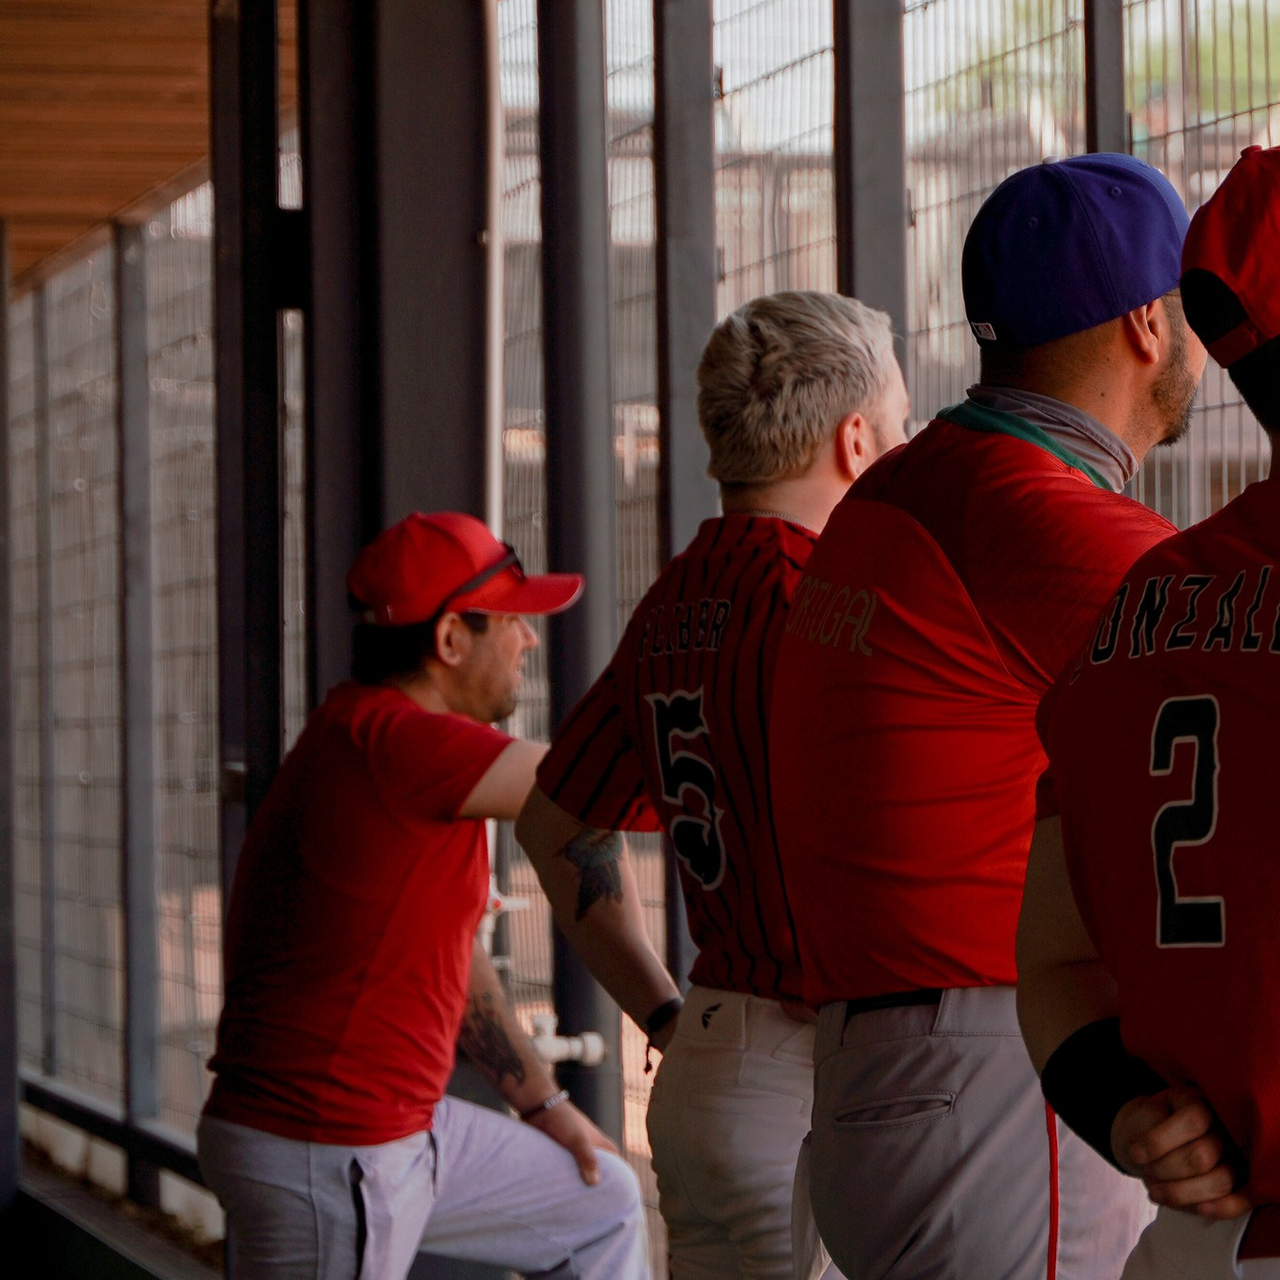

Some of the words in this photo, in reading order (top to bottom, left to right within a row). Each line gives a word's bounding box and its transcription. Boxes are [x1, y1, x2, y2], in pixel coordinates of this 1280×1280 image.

[785, 571, 877, 657] ORTUGAL
[643, 684, 728, 891] 5
[1149, 694, 1226, 949] 2
